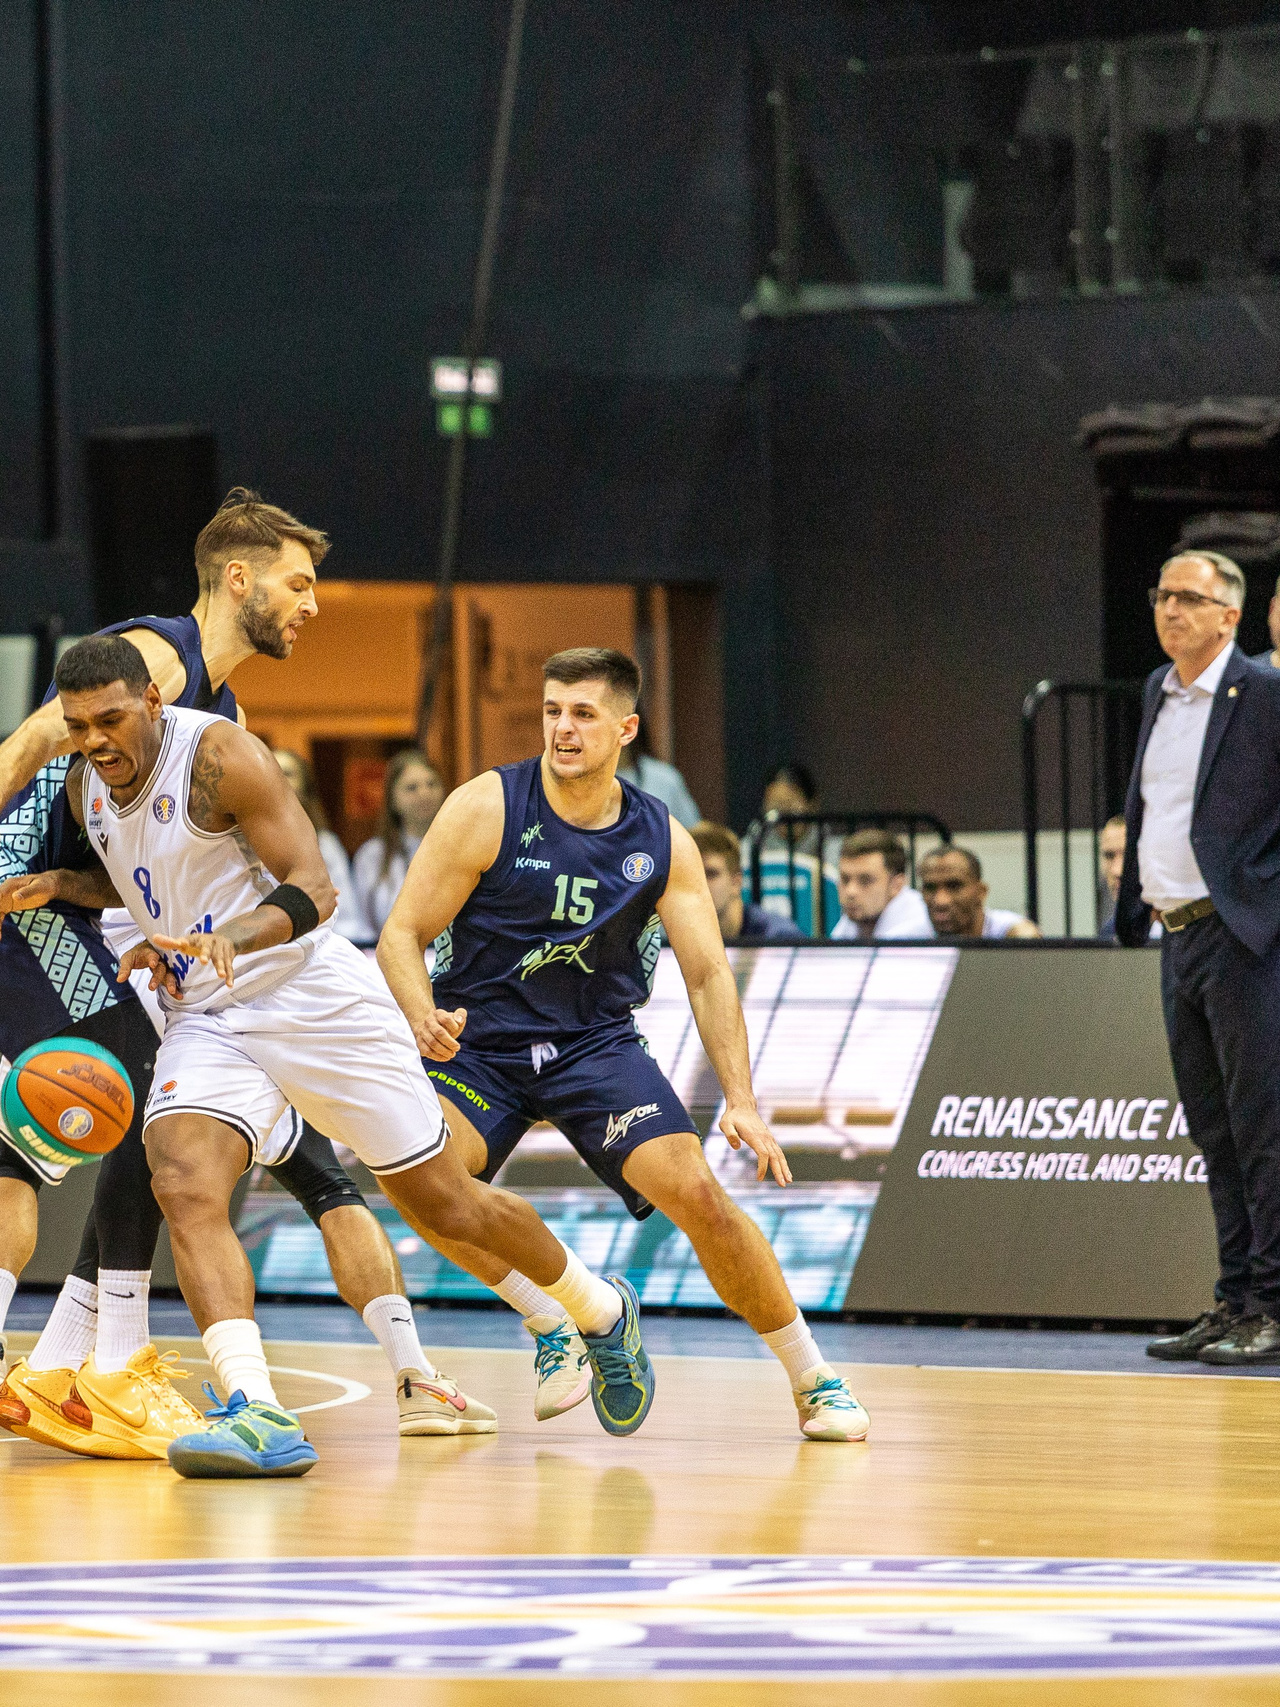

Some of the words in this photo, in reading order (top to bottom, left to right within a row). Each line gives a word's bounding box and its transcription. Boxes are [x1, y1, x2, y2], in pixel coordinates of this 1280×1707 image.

[133, 867, 160, 919] 8
[551, 874, 598, 925] 15
[930, 1095, 1169, 1141] RENAISSANCE
[917, 1150, 1026, 1180] CONGRESS
[1023, 1152, 1091, 1182] HOTEL
[1091, 1153, 1142, 1183] AND
[1139, 1154, 1183, 1183] SPA
